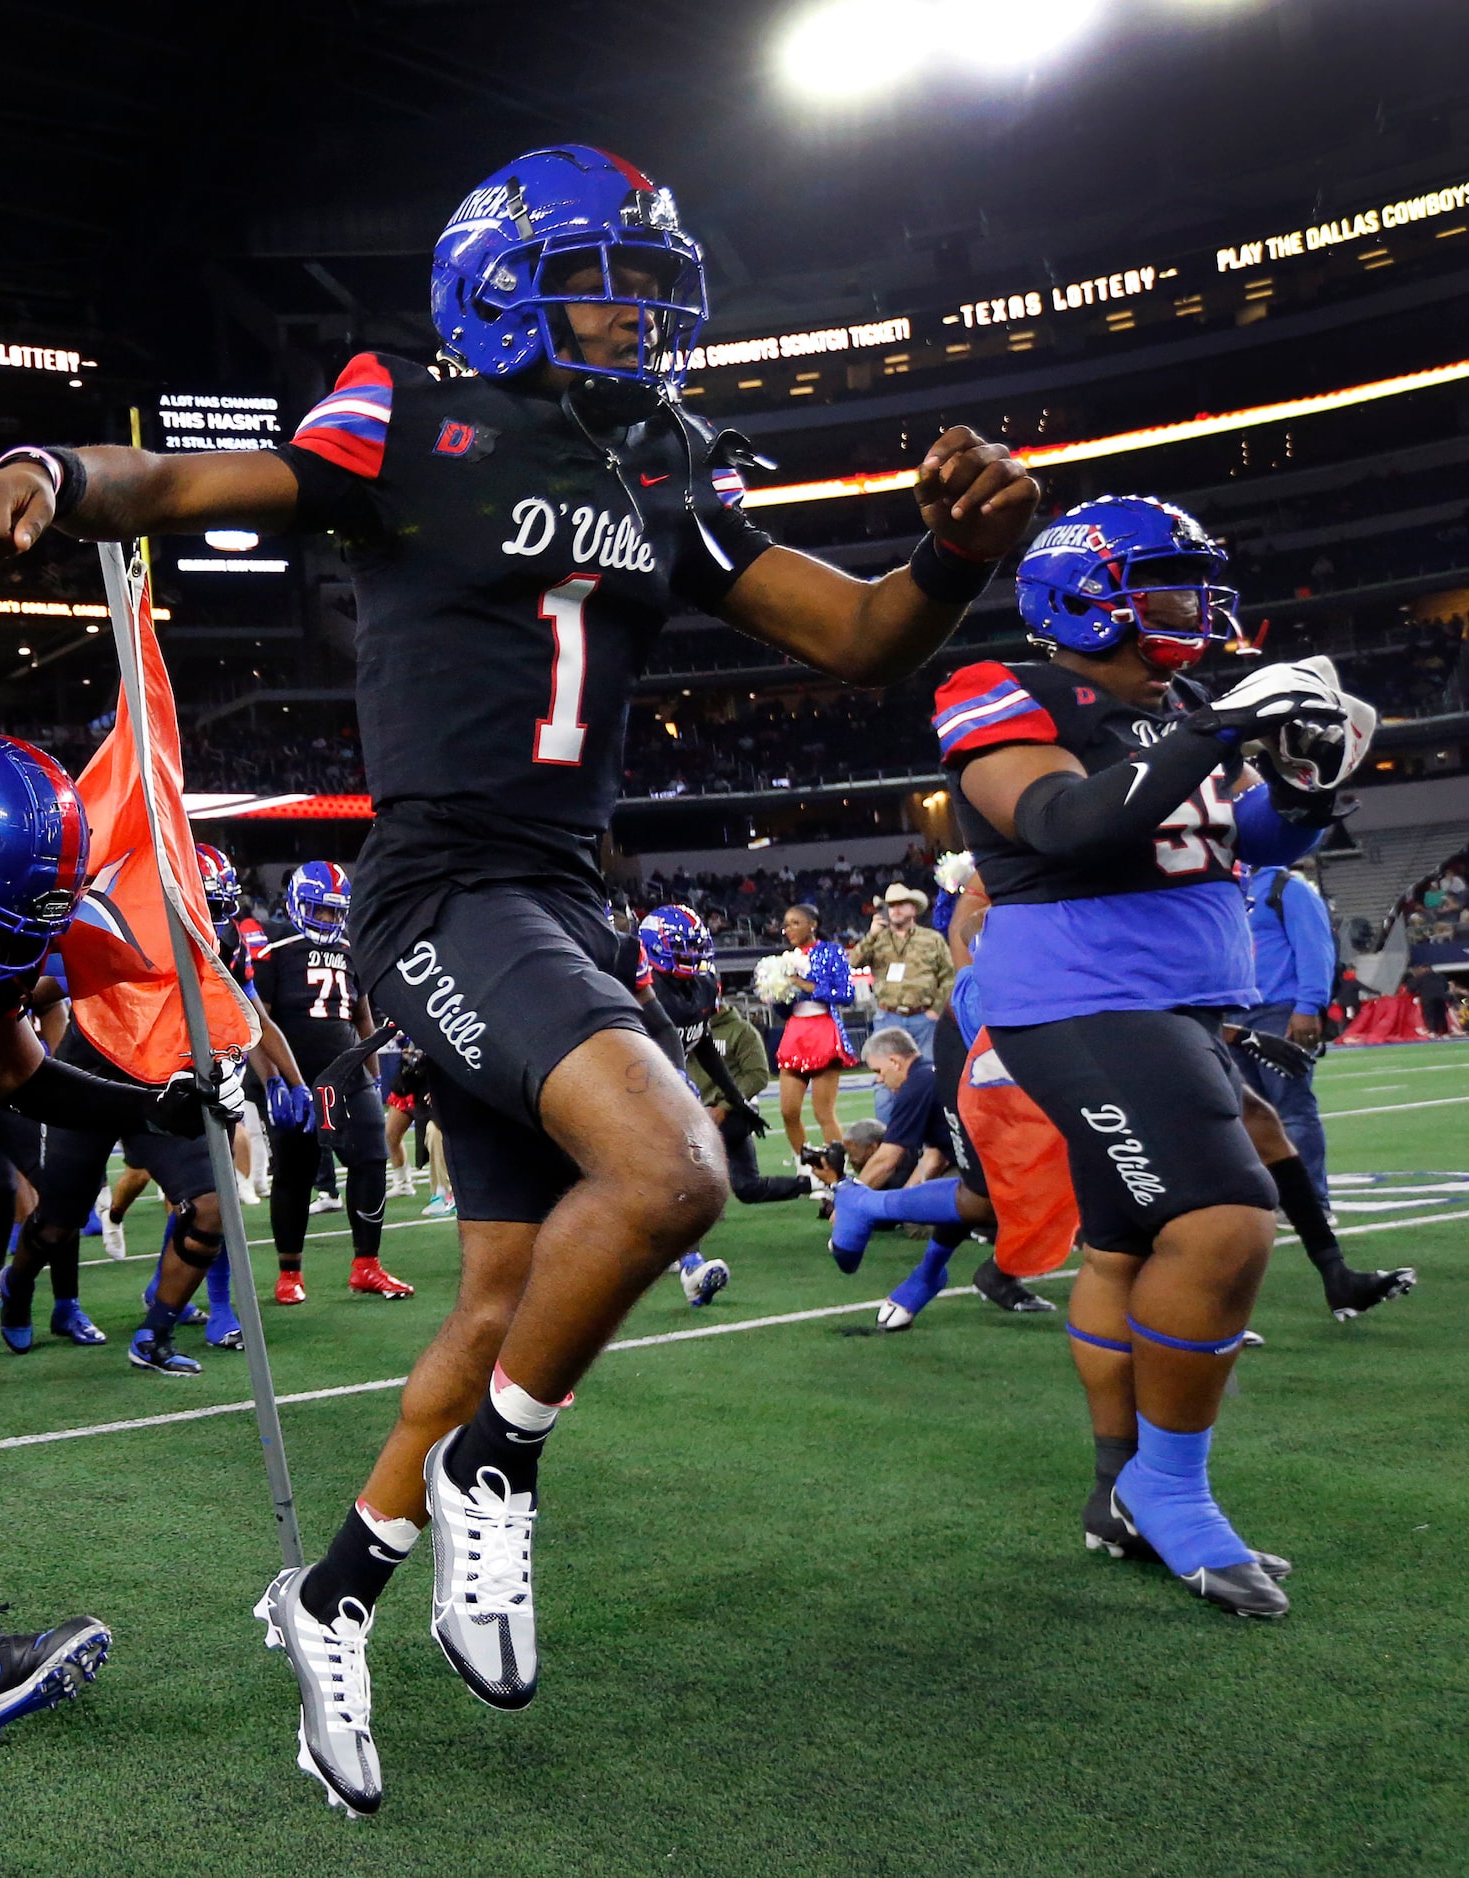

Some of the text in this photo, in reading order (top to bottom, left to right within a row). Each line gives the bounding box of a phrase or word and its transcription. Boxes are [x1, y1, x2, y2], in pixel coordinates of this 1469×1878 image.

[1217, 241, 1266, 272] PLAY
[1266, 229, 1305, 260] THE
[1306, 210, 1379, 251] DALLAS
[159, 411, 281, 431] THIS HASN'T.
[181, 436, 216, 449] STILL
[501, 496, 655, 573] D'Ville
[532, 572, 602, 767] 1
[306, 967, 352, 1020] 71
[396, 940, 486, 1070] D'Ville
[1081, 1104, 1167, 1206] D'Ville
